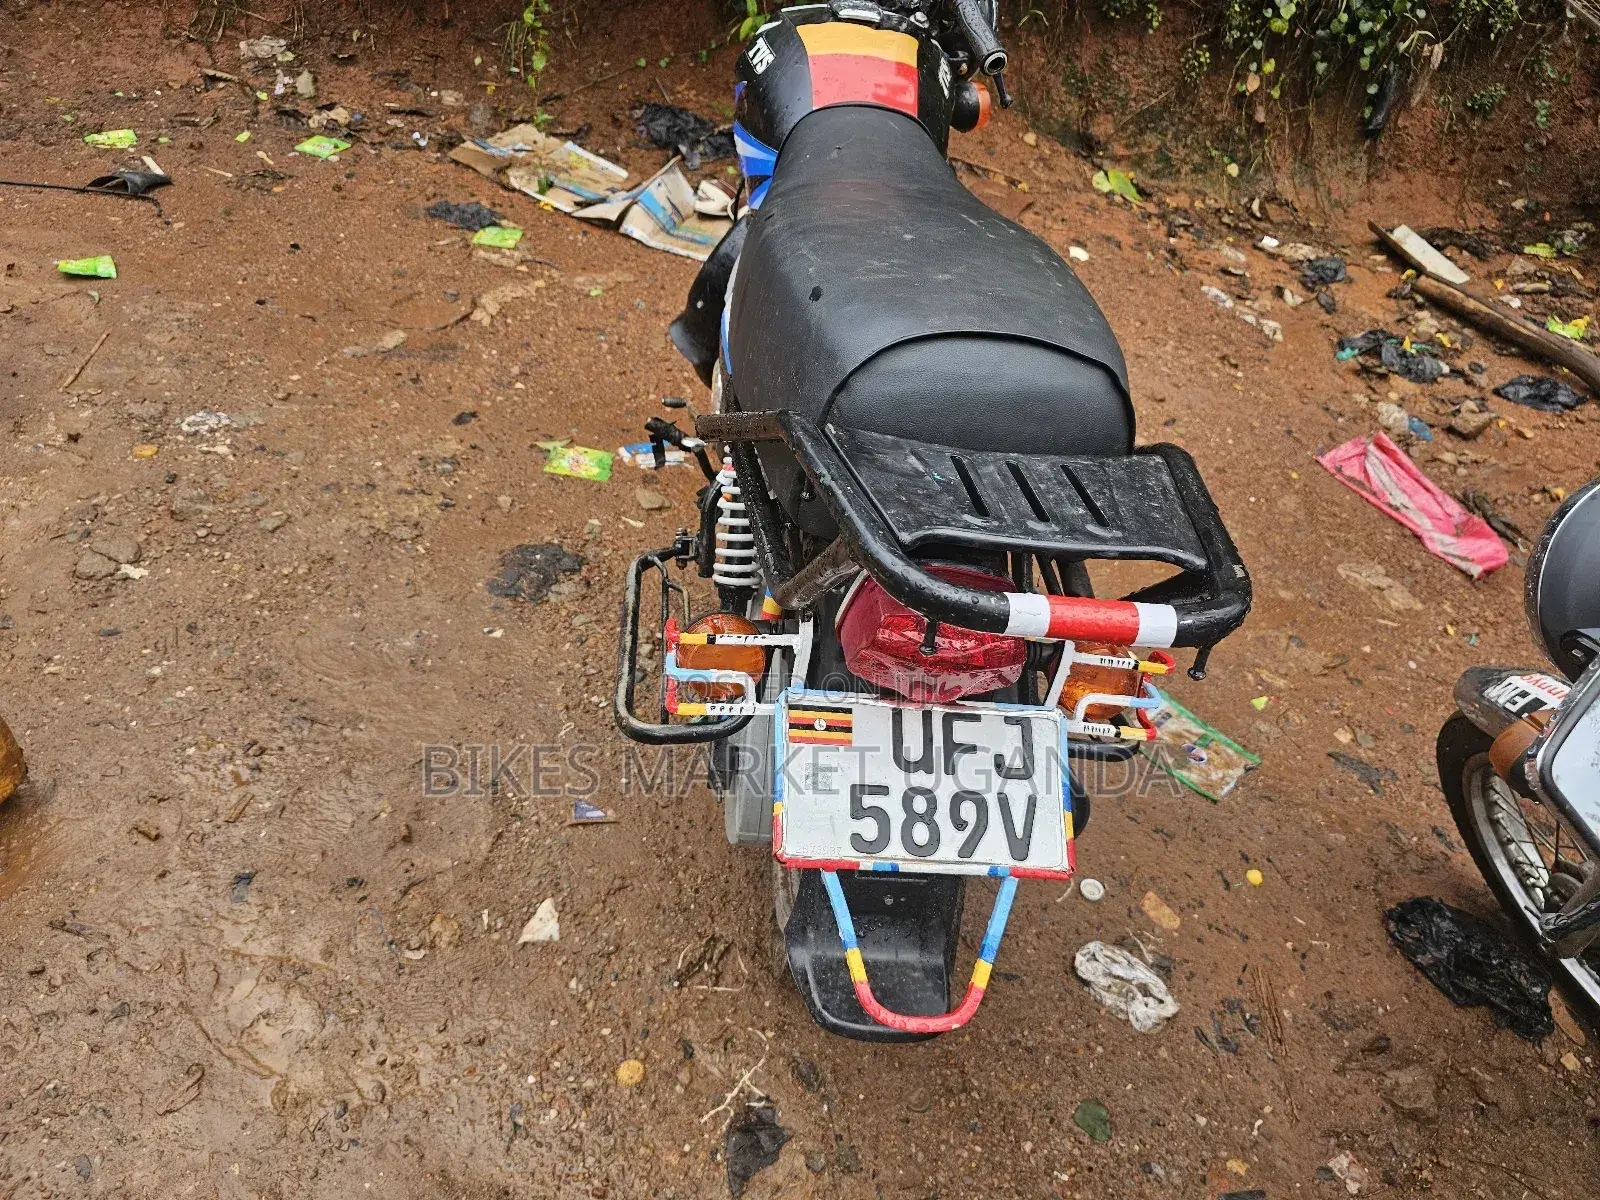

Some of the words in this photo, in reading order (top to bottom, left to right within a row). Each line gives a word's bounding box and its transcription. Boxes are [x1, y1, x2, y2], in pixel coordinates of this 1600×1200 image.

[747, 36, 776, 74] TVS
[891, 707, 1034, 781] UFJ
[849, 784, 1037, 862] 589V
